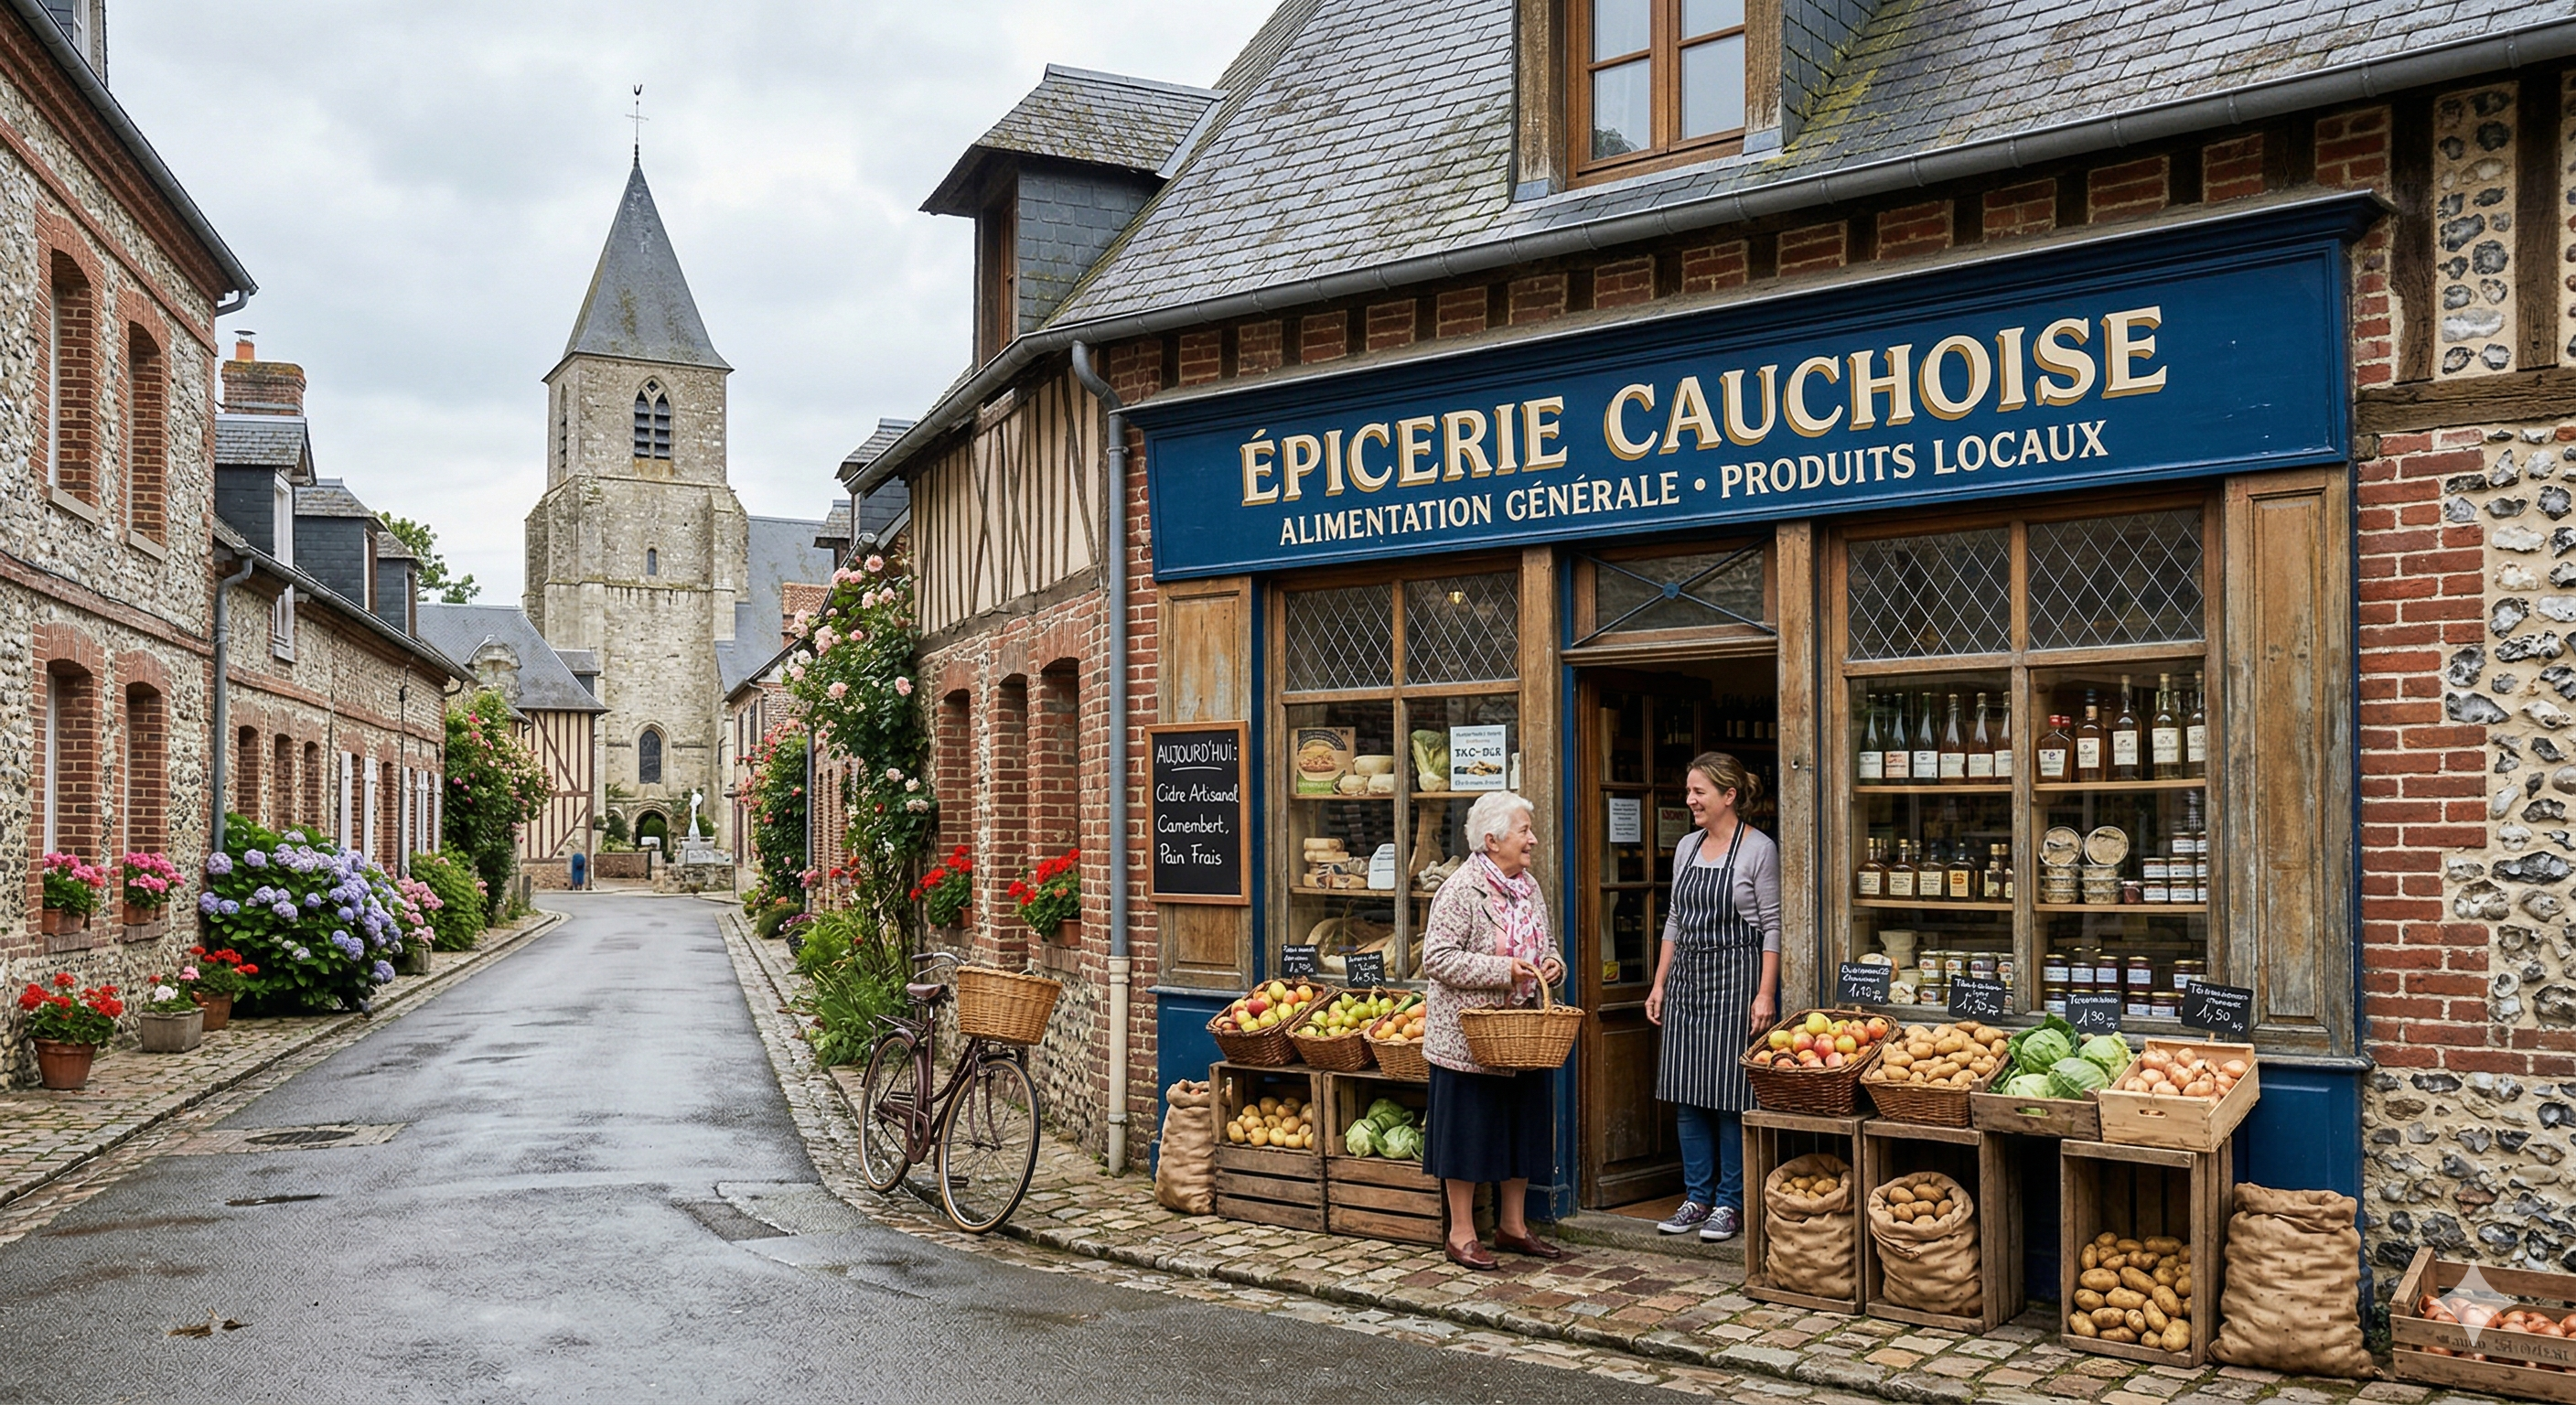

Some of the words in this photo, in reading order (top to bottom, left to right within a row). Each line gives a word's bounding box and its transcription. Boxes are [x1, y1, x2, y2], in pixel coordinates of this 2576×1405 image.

[1240, 396, 1568, 507] ÉPICERIE
[1604, 306, 2168, 462] CAUCHOISE
[1279, 494, 1493, 546] ALIMENTATION
[1505, 471, 1681, 521] GÉNÉRALE
[1720, 442, 1916, 499] PRODUITS
[1934, 418, 2109, 476] LOCAUX
[1156, 783, 1186, 803] Cidre
[1157, 813, 1230, 834] Camembert,
[1159, 842, 1186, 864] Pain
[1190, 843, 1223, 865] Frais
[2195, 1003, 2231, 1024] 1,50
